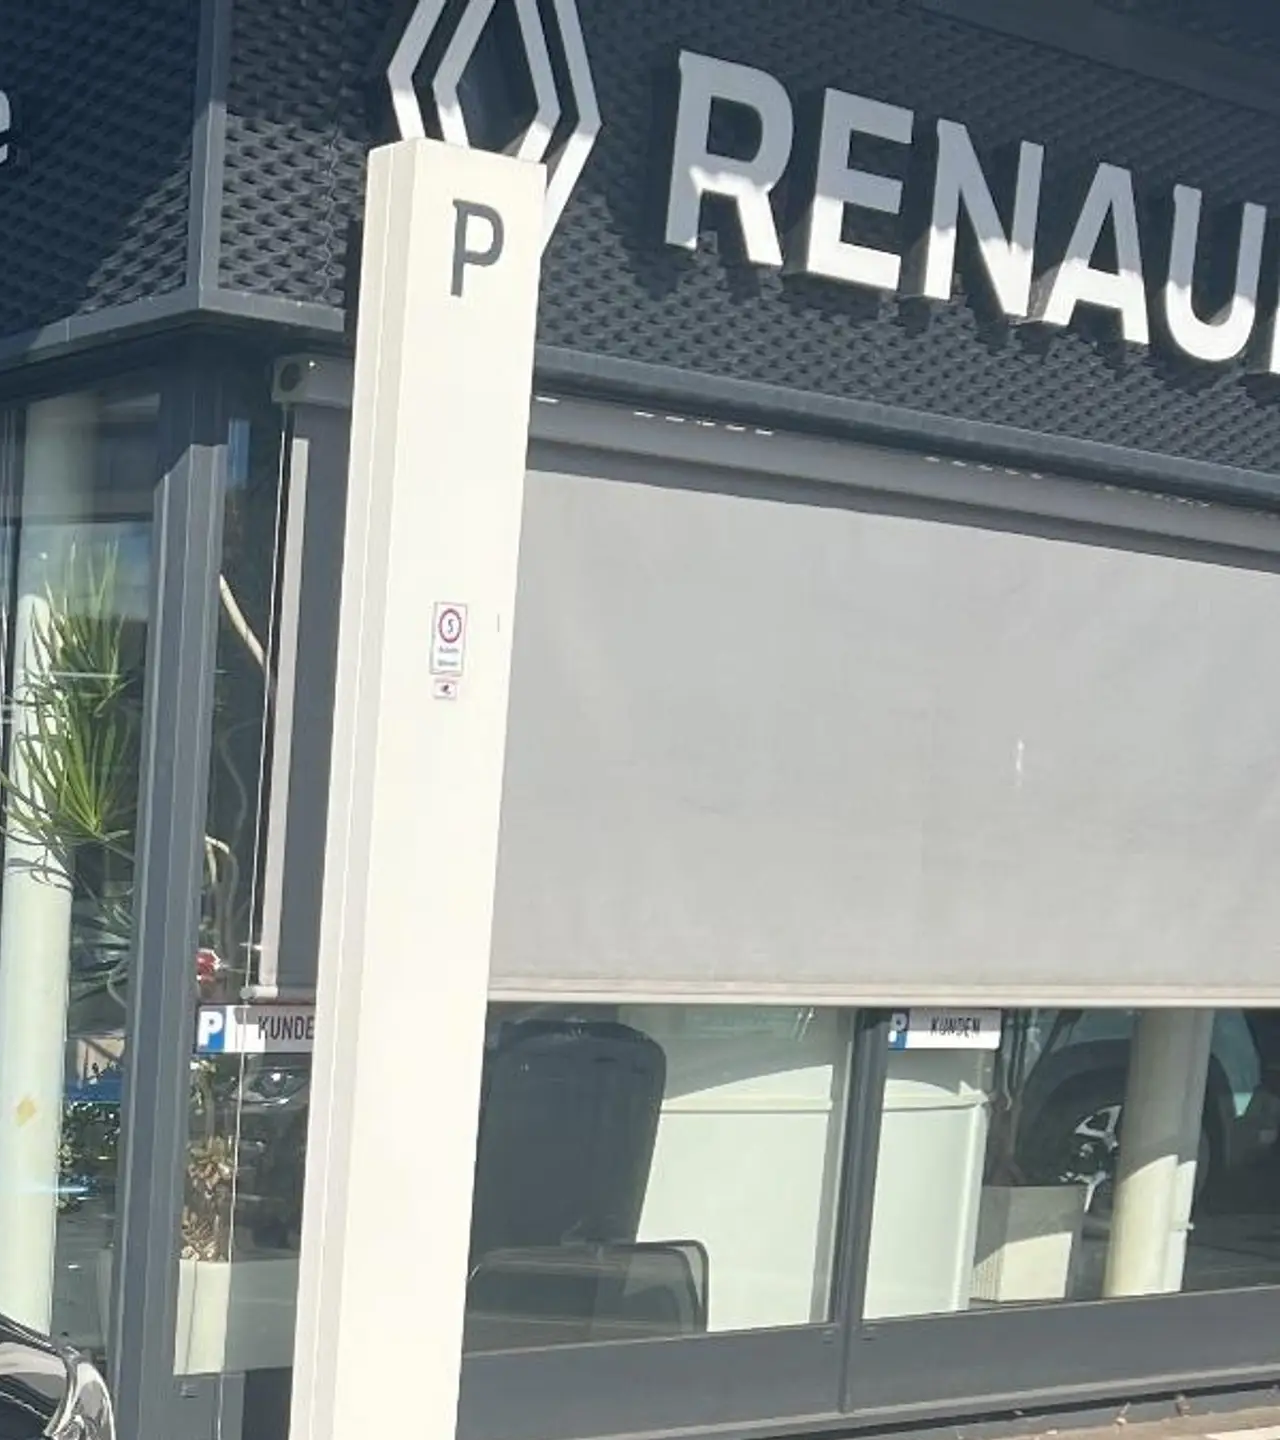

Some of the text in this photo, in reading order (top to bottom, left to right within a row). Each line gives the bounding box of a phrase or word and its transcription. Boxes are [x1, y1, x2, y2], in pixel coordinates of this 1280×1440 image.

[450, 198, 504, 297] P
[664, 50, 1280, 373] RENAU
[198, 1010, 316, 1047] P KUNDE
